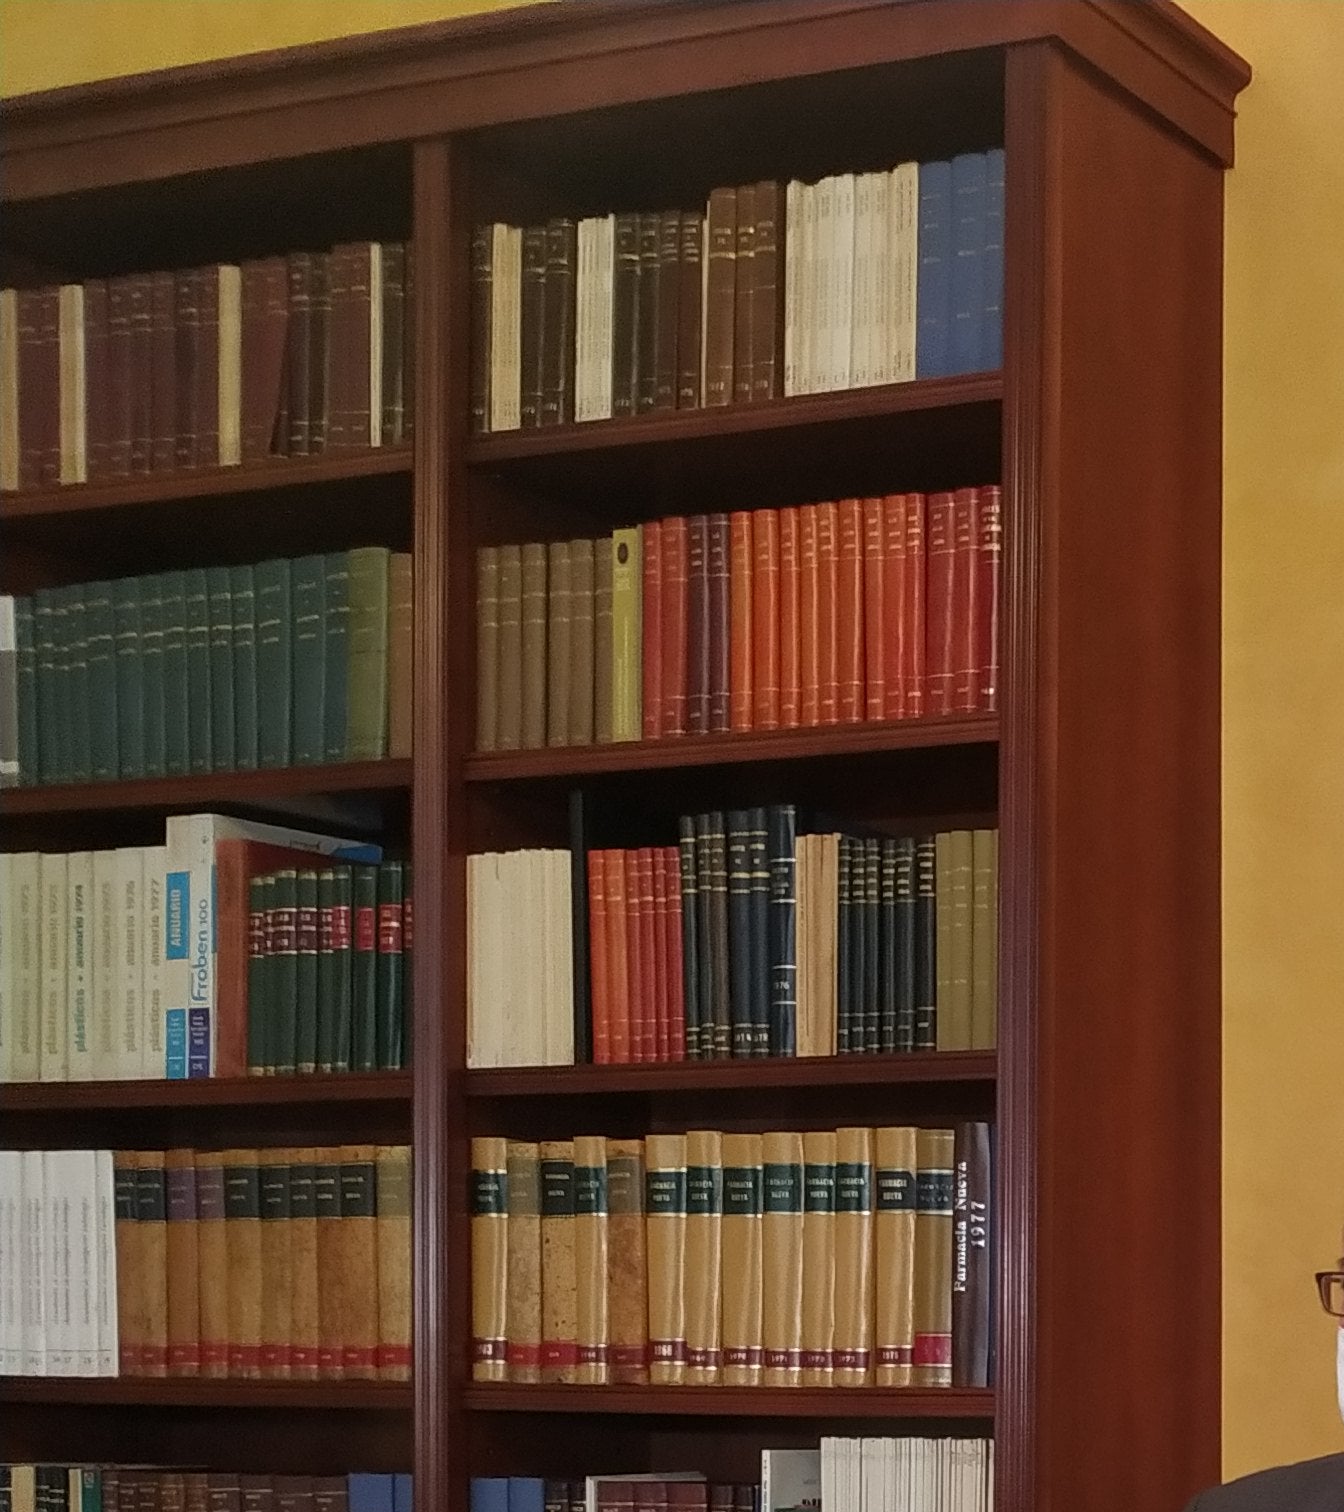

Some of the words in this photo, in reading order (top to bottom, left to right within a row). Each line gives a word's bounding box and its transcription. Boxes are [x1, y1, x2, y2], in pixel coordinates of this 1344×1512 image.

[170, 889, 181, 947] ANUARIO
[191, 930, 208, 1002] Froben
[955, 1161, 967, 1211] Nueva
[970, 1201, 985, 1248] 1977
[954, 1221, 967, 1292] Farmacia
